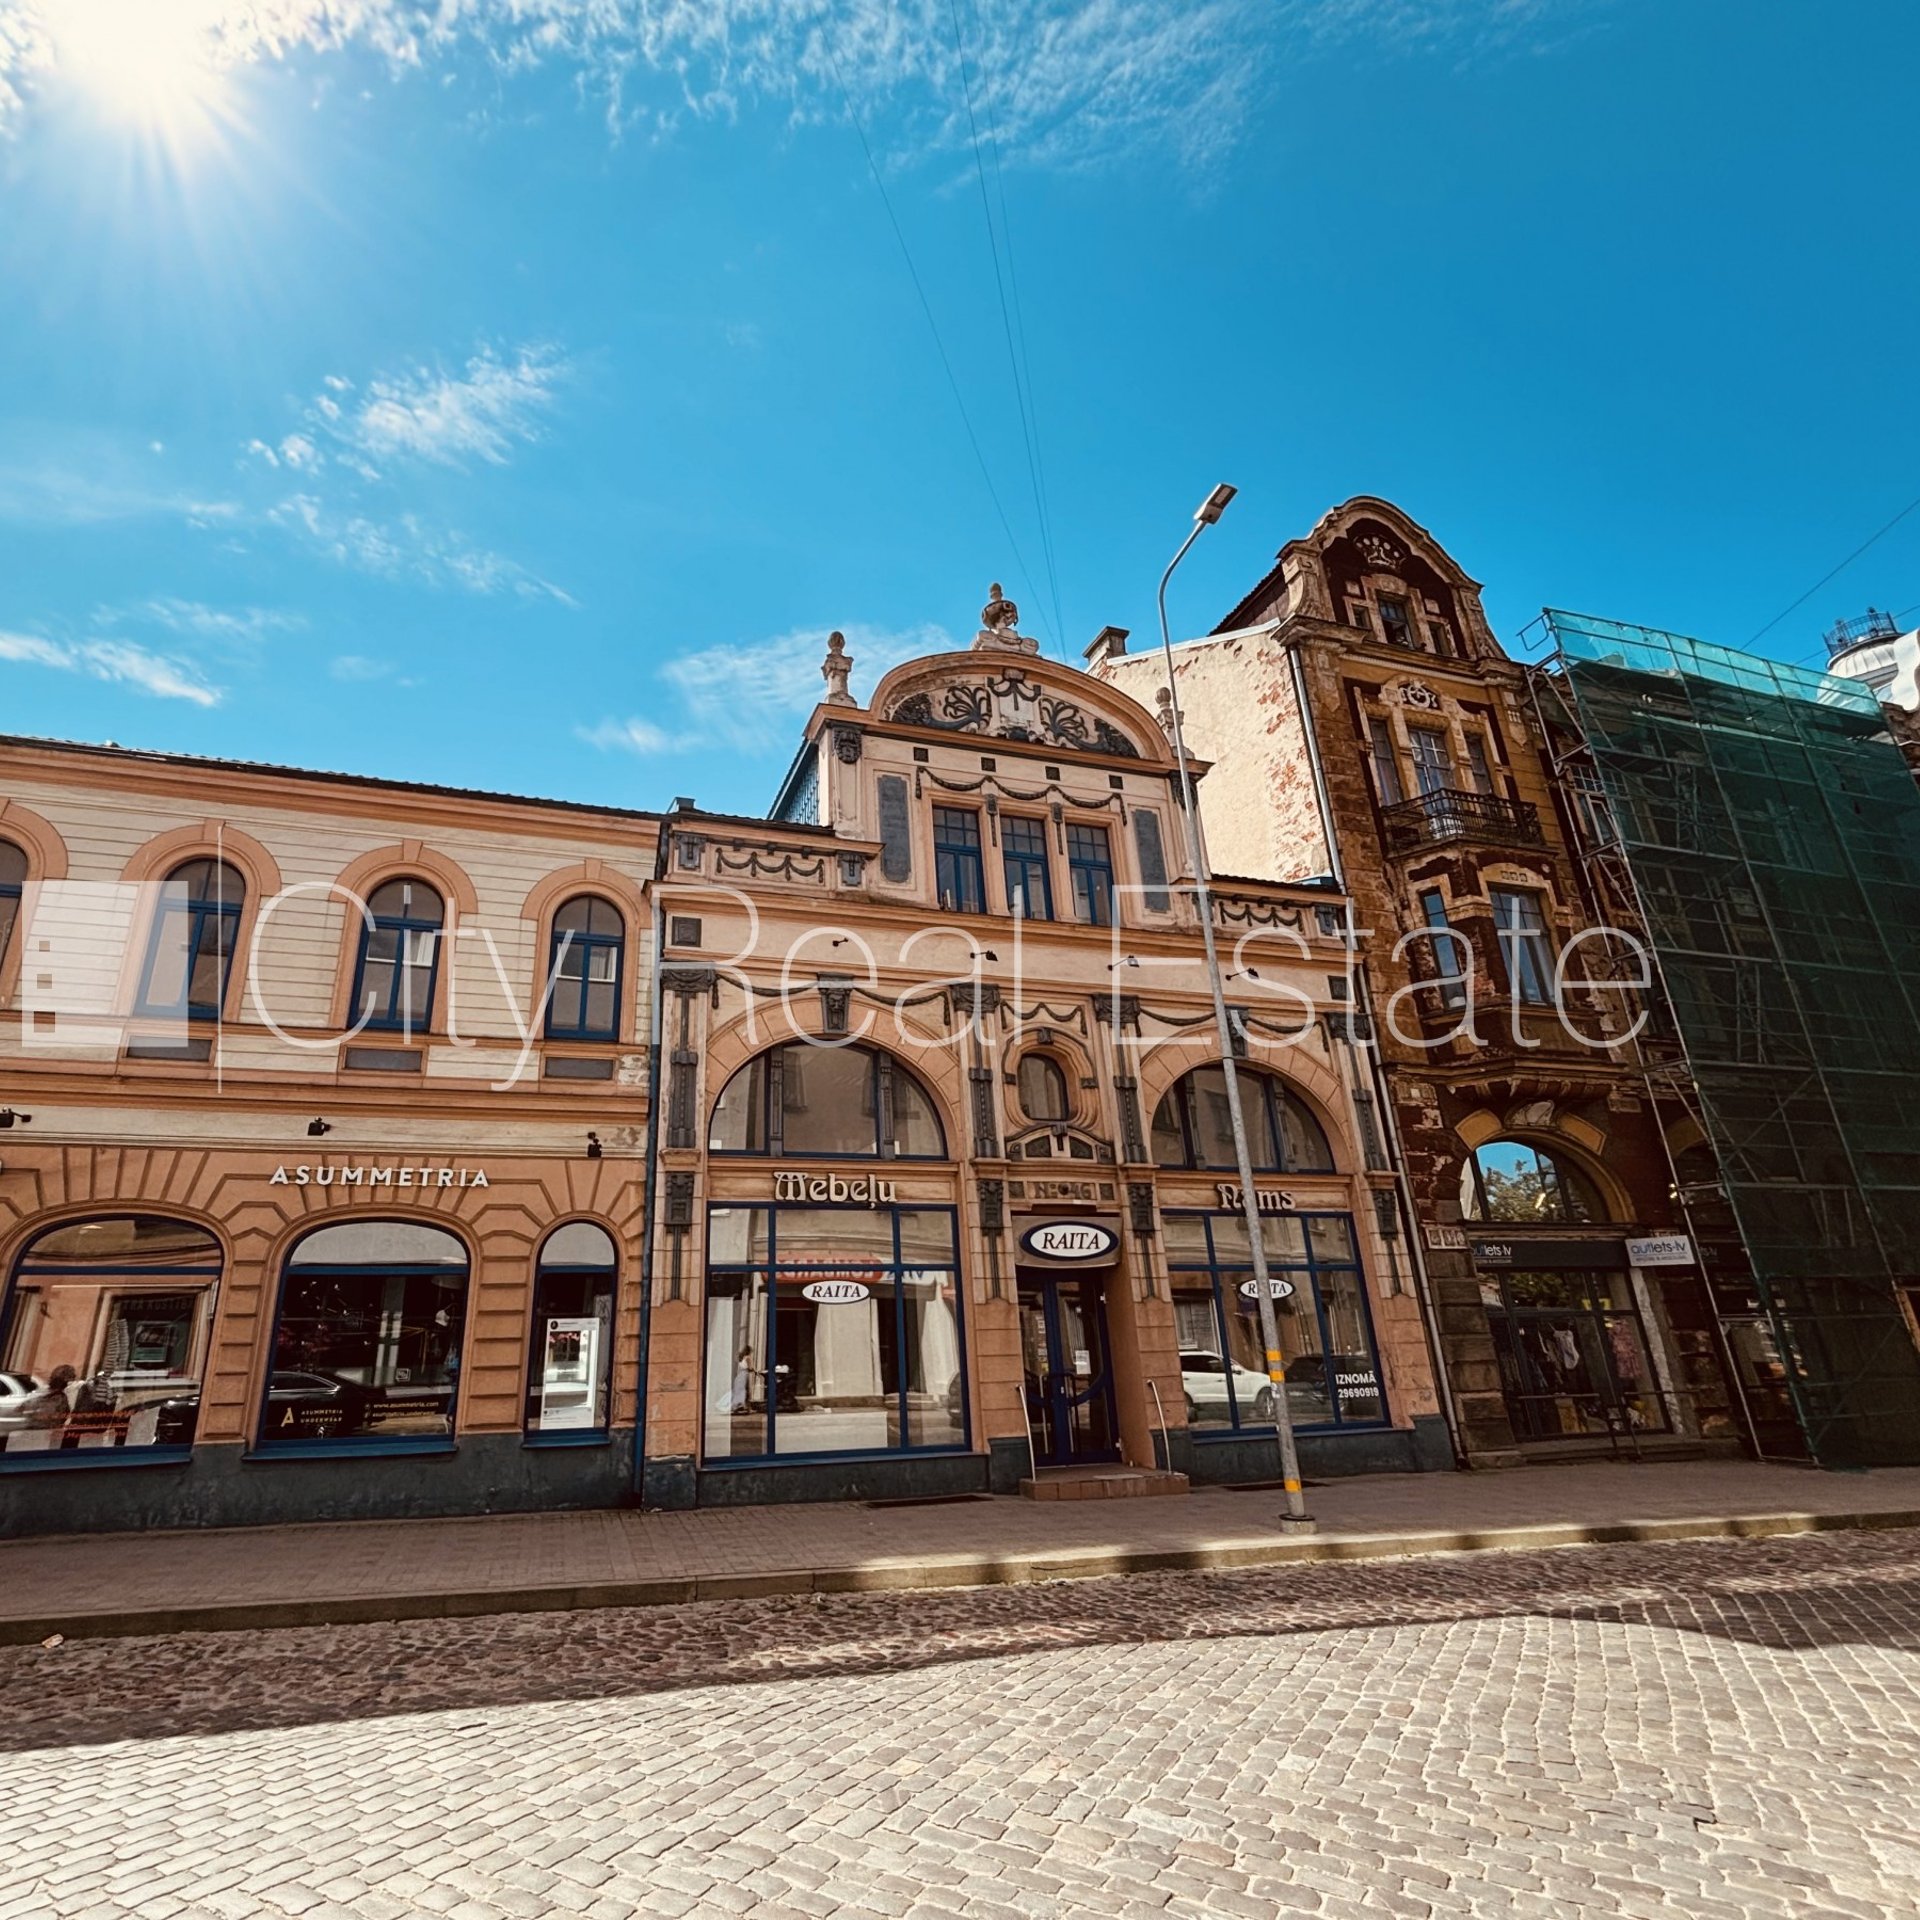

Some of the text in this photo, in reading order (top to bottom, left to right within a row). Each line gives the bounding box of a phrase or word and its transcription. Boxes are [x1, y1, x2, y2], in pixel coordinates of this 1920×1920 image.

[270, 1164, 490, 1188] ASUMMETRIA
[1216, 1183, 1297, 1210] Nms
[1042, 1232, 1101, 1250] RAITA
[811, 1285, 862, 1298] RAITA
[1248, 1283, 1287, 1295] RTA
[1335, 1370, 1378, 1385] IZNOMĀ
